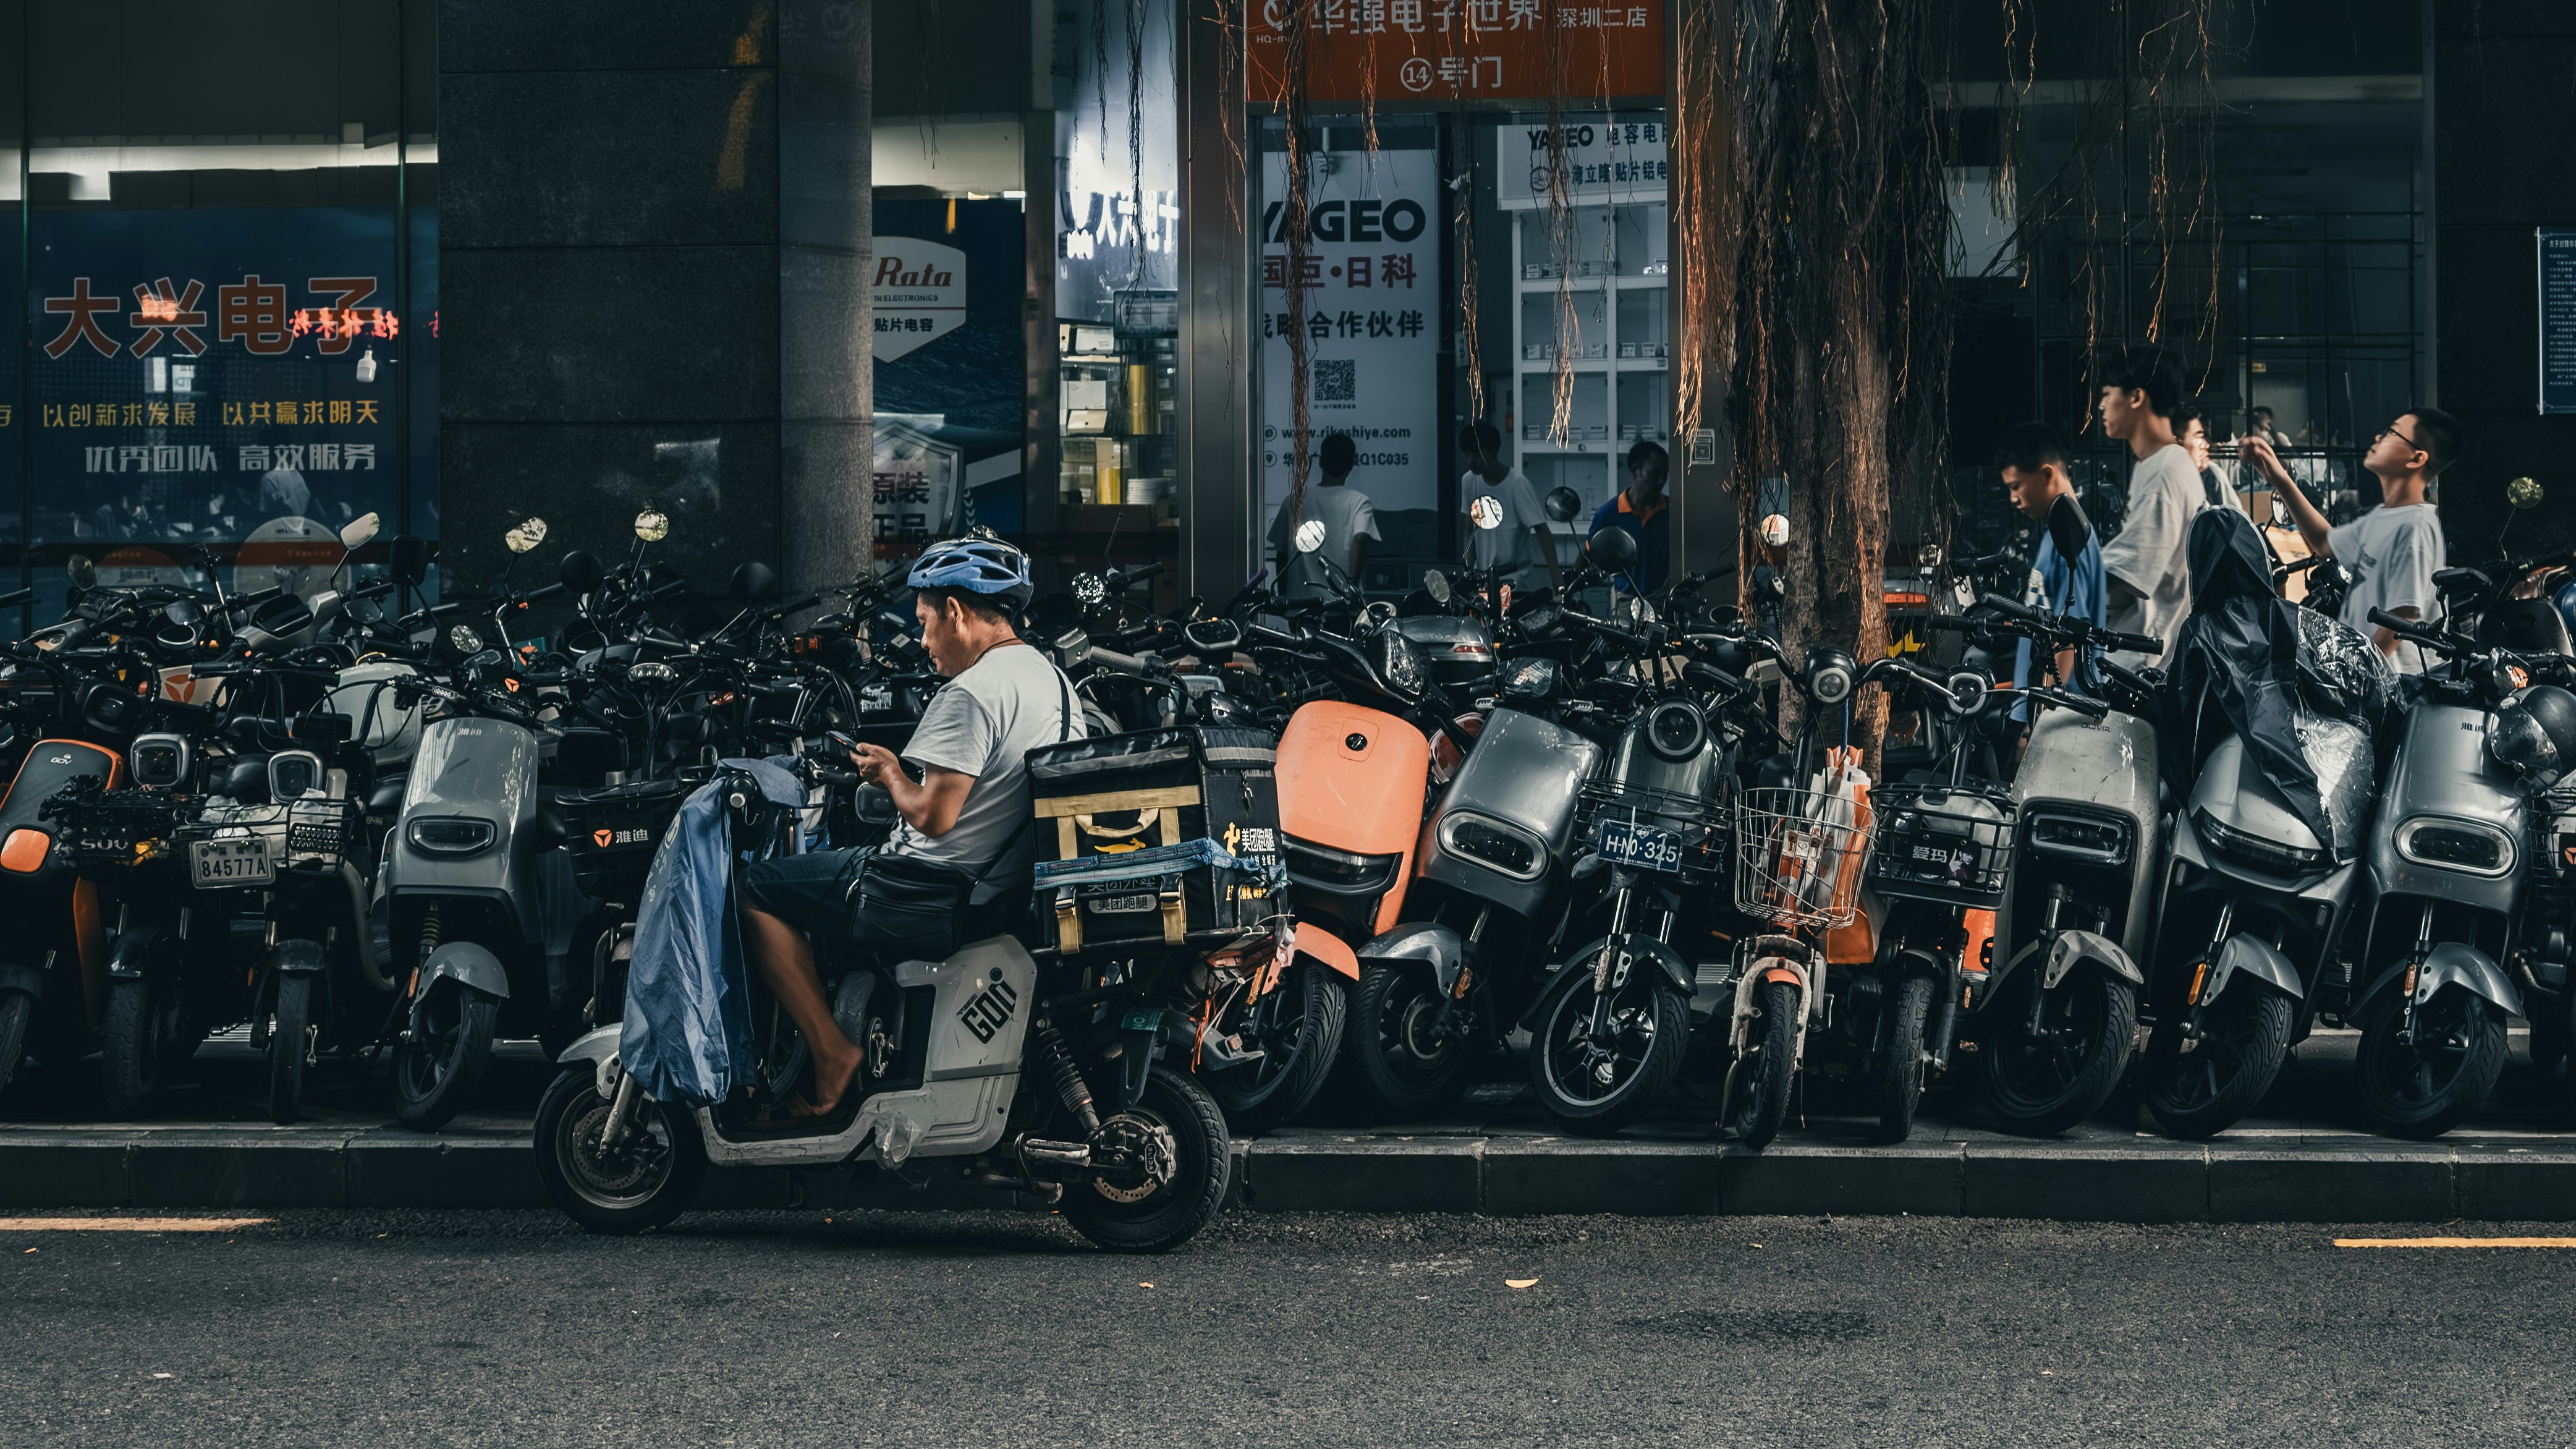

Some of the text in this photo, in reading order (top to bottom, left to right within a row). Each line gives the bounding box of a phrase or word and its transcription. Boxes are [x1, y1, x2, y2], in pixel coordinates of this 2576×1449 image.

[1556, 6, 1648, 28] 深圳二店
[1527, 125, 1595, 150] YAEO
[44, 274, 382, 359] 大兴电子
[874, 317, 934, 333] 贴片电容
[43, 400, 379, 428] 以创新求发展 以共赢求明天
[1282, 426, 1411, 441] ww.rikeshiye.com
[85, 443, 376, 473] 优秀团队 高效服务
[873, 472, 930, 505] 原装
[80, 838, 129, 851] SUV
[616, 828, 649, 843] 雅迪
[1241, 828, 1276, 852] 美团跑腿
[201, 857, 266, 877] 84577A
[1098, 896, 1148, 911] 美团跑腿
